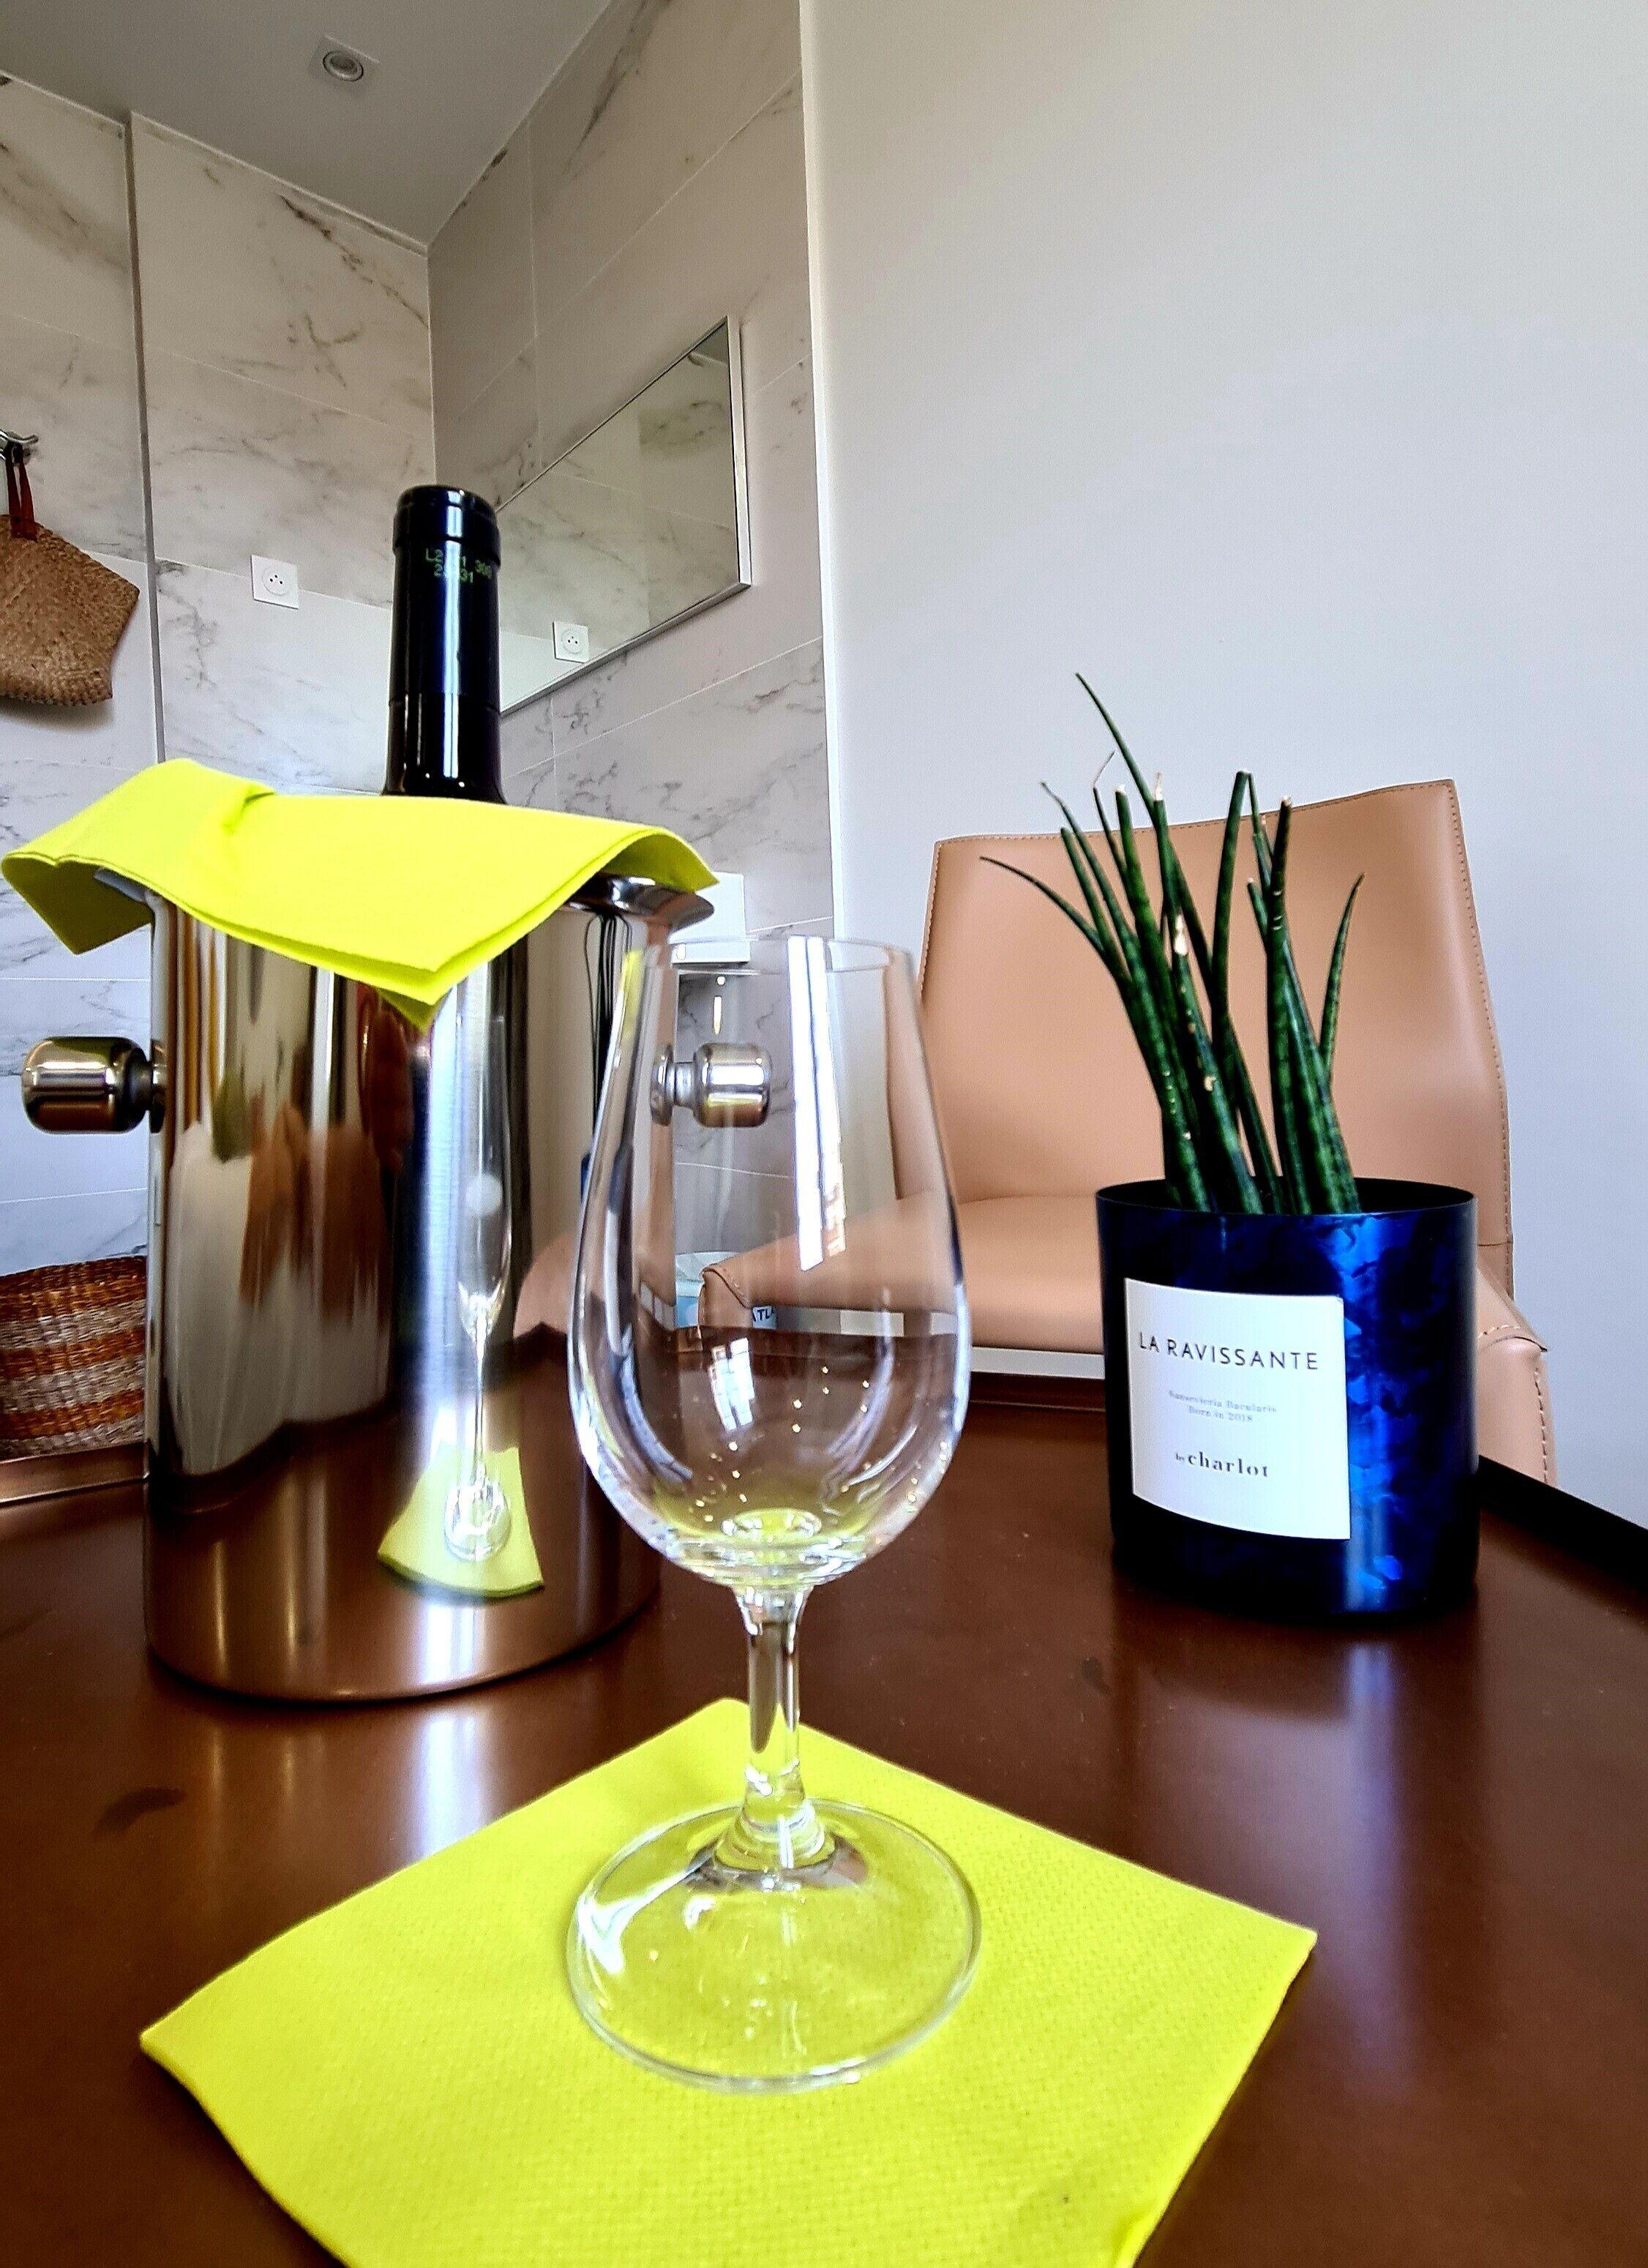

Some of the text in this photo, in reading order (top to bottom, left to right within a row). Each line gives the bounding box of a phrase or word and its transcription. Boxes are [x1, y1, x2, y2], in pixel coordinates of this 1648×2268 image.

[1139, 1331, 1319, 1370] LA RAVISSANTE
[1188, 1404, 1254, 1423] Born in 2018
[1188, 1451, 1267, 1477] charlot
